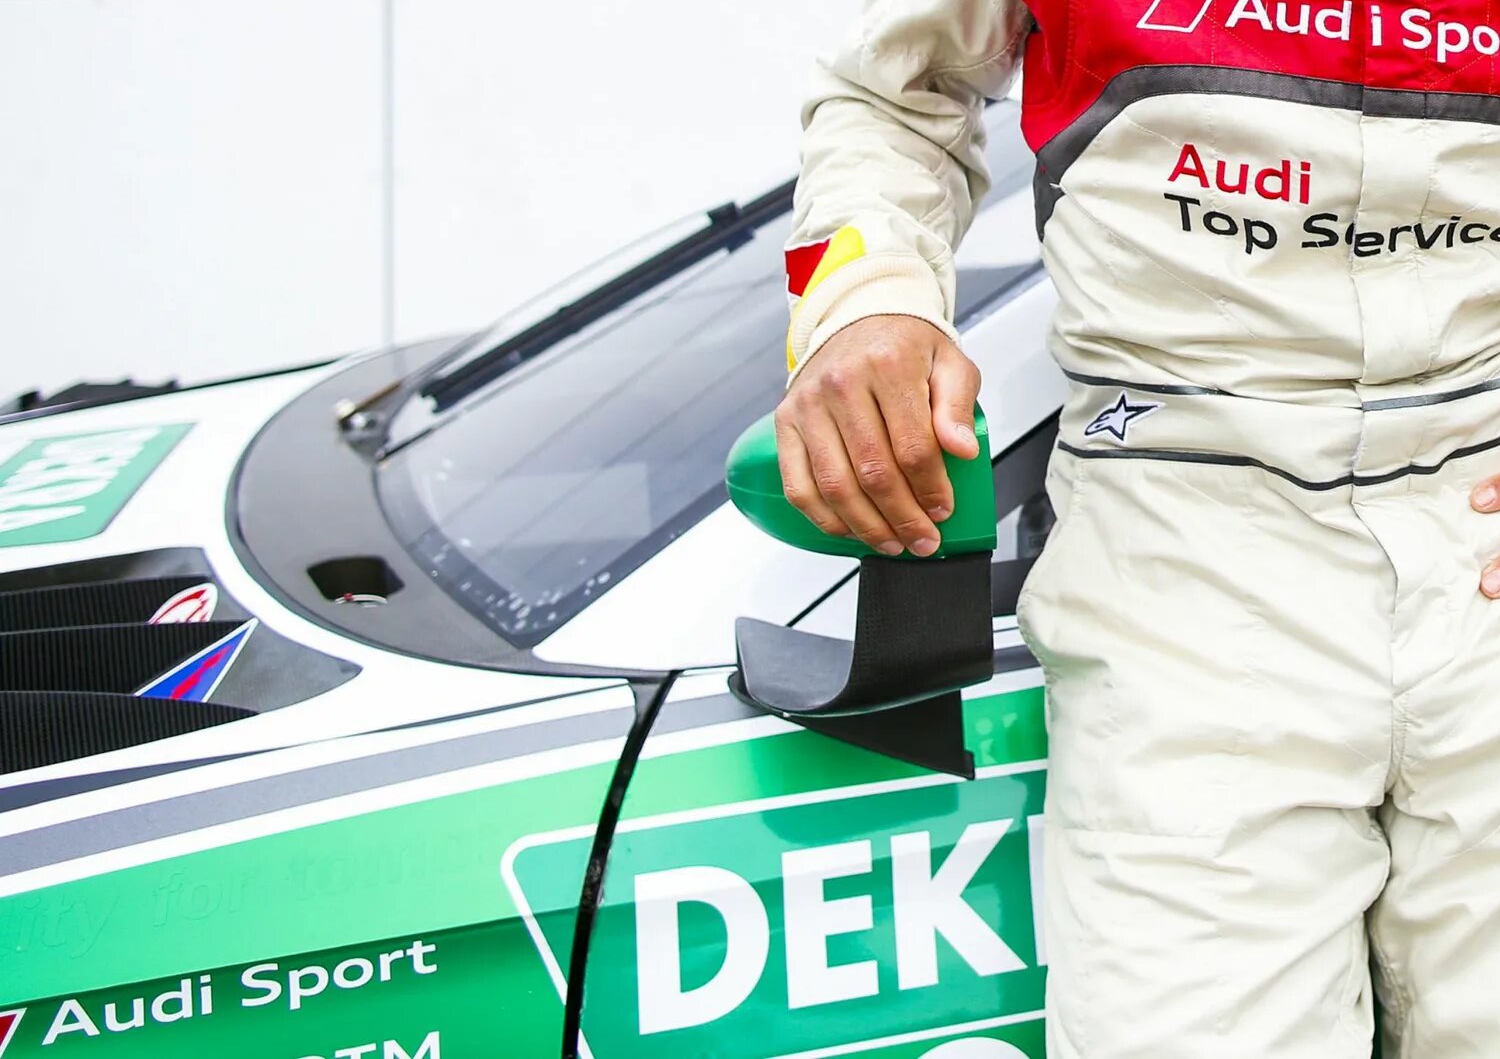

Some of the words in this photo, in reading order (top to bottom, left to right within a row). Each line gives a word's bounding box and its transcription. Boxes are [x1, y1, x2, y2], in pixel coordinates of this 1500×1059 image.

[1167, 143, 1313, 205] Audi
[1163, 192, 1279, 254] Top
[41, 972, 215, 1046] Audi
[239, 939, 439, 1011] Sport
